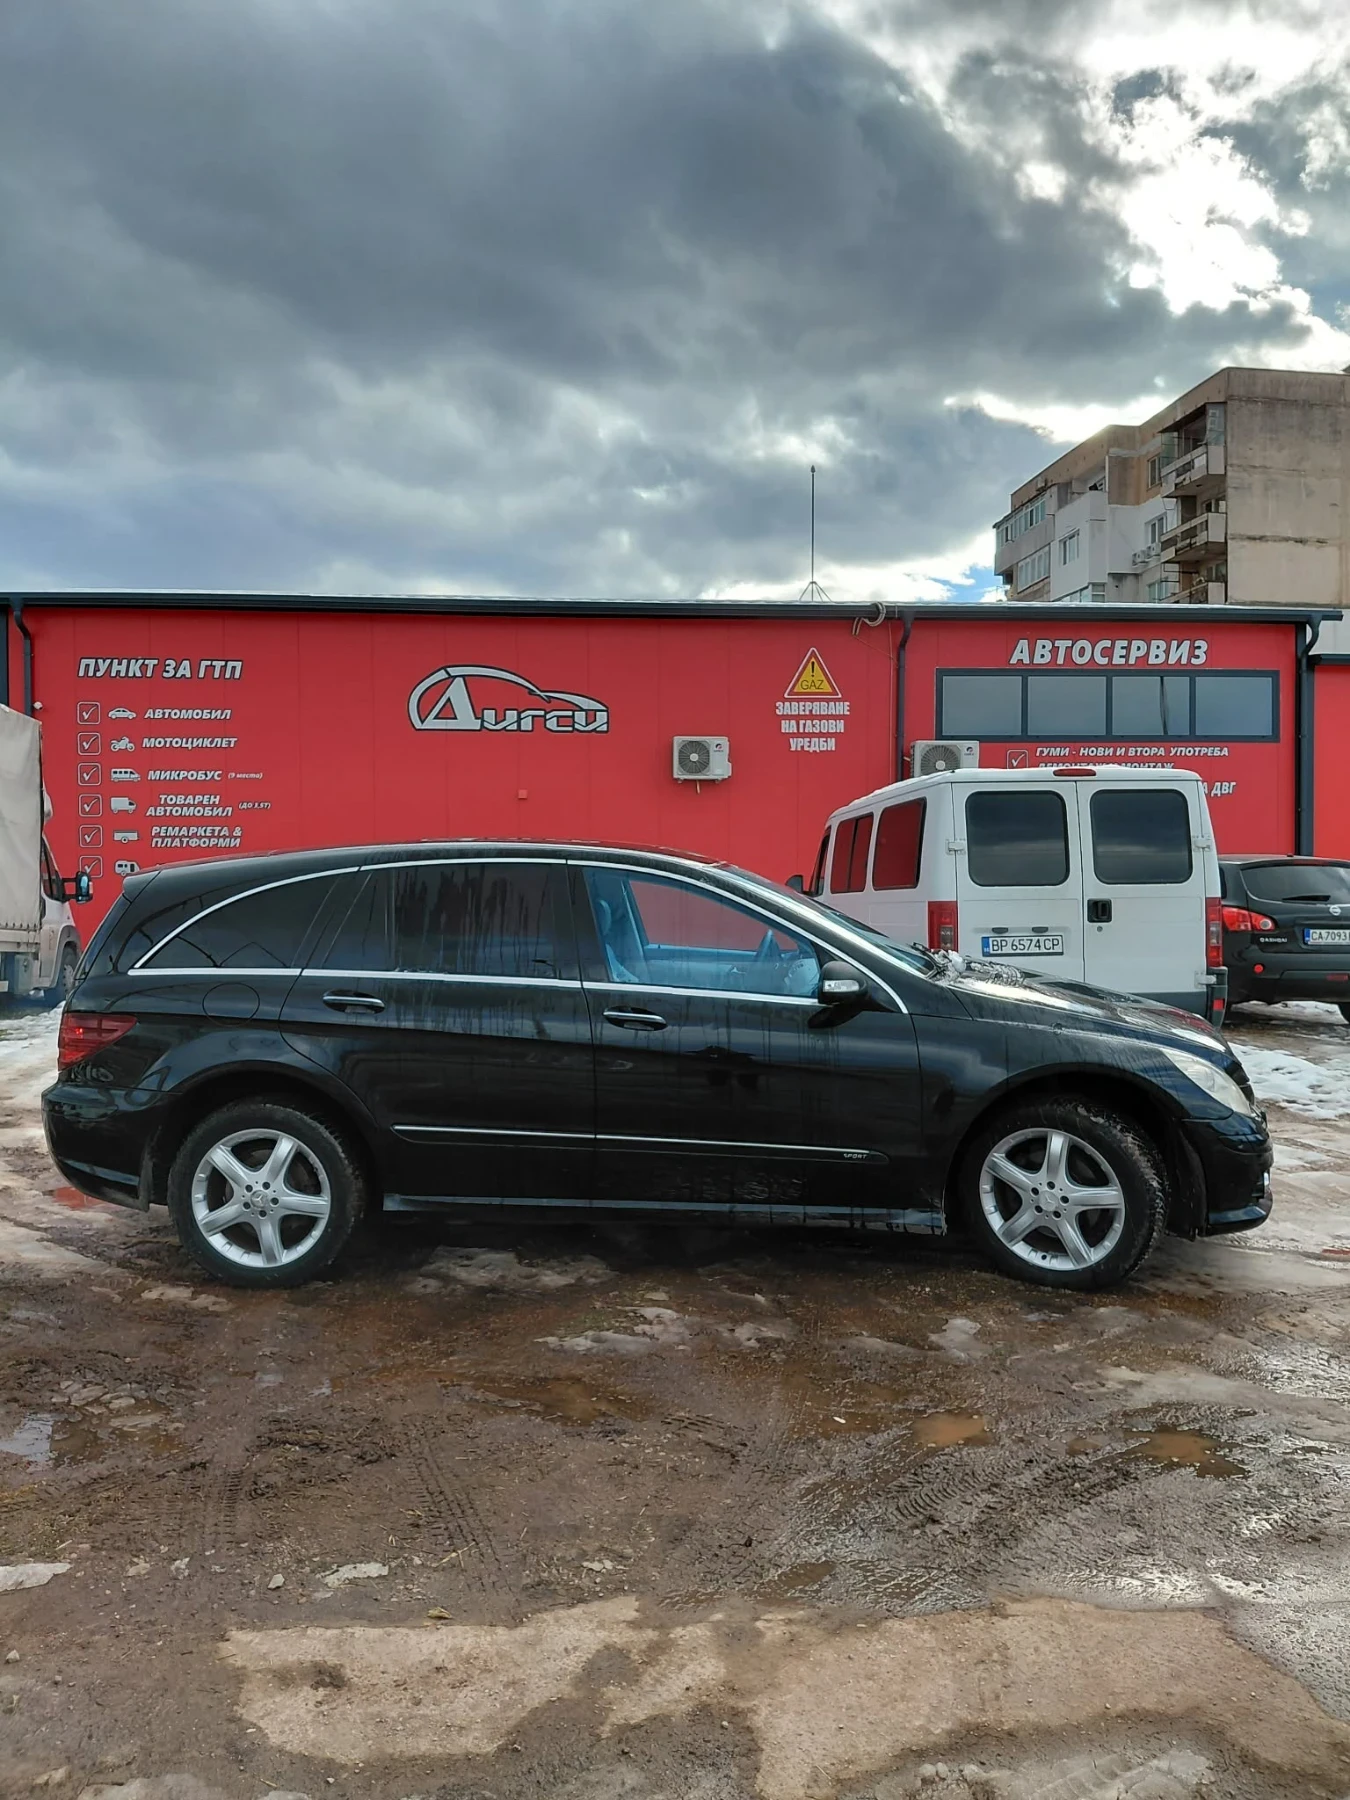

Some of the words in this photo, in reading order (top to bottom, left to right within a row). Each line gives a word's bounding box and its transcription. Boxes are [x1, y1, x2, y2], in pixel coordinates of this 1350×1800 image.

[1009, 639, 1209, 665] АВТОСЕРВИЗ
[78, 658, 158, 678] ПУНКТ
[162, 660, 192, 679] ЗА
[198, 660, 243, 679] ГТП
[800, 679, 824, 690] GAZ
[144, 708, 232, 720] АВТОМОБИЛ
[775, 701, 851, 715] ЗАВЕРЯВАНЕ
[781, 719, 797, 733] НА
[798, 719, 844, 733] ГАЗОВИ
[142, 737, 238, 750] МОТОЦИКЛЕТ
[789, 737, 836, 752] УРЕДБИ
[1035, 747, 1070, 757] ГУМИ
[1079, 747, 1113, 757] НОВИ
[1115, 747, 1125, 757] И
[1127, 747, 1165, 757] ВТОРА
[1169, 747, 1229, 757] УПОТРЕБА
[147, 770, 223, 781] МИКРОБУС
[1210, 781, 1237, 797] ДВГ
[159, 794, 220, 805] ТОВАРЕН
[145, 806, 233, 817] АВТОМОБИЛ
[151, 826, 229, 837] РЕМАРКЕТА
[233, 826, 242, 837] &
[151, 837, 241, 848] ПЛАТФОРМИ
[1010, 938, 1041, 952] 6574
